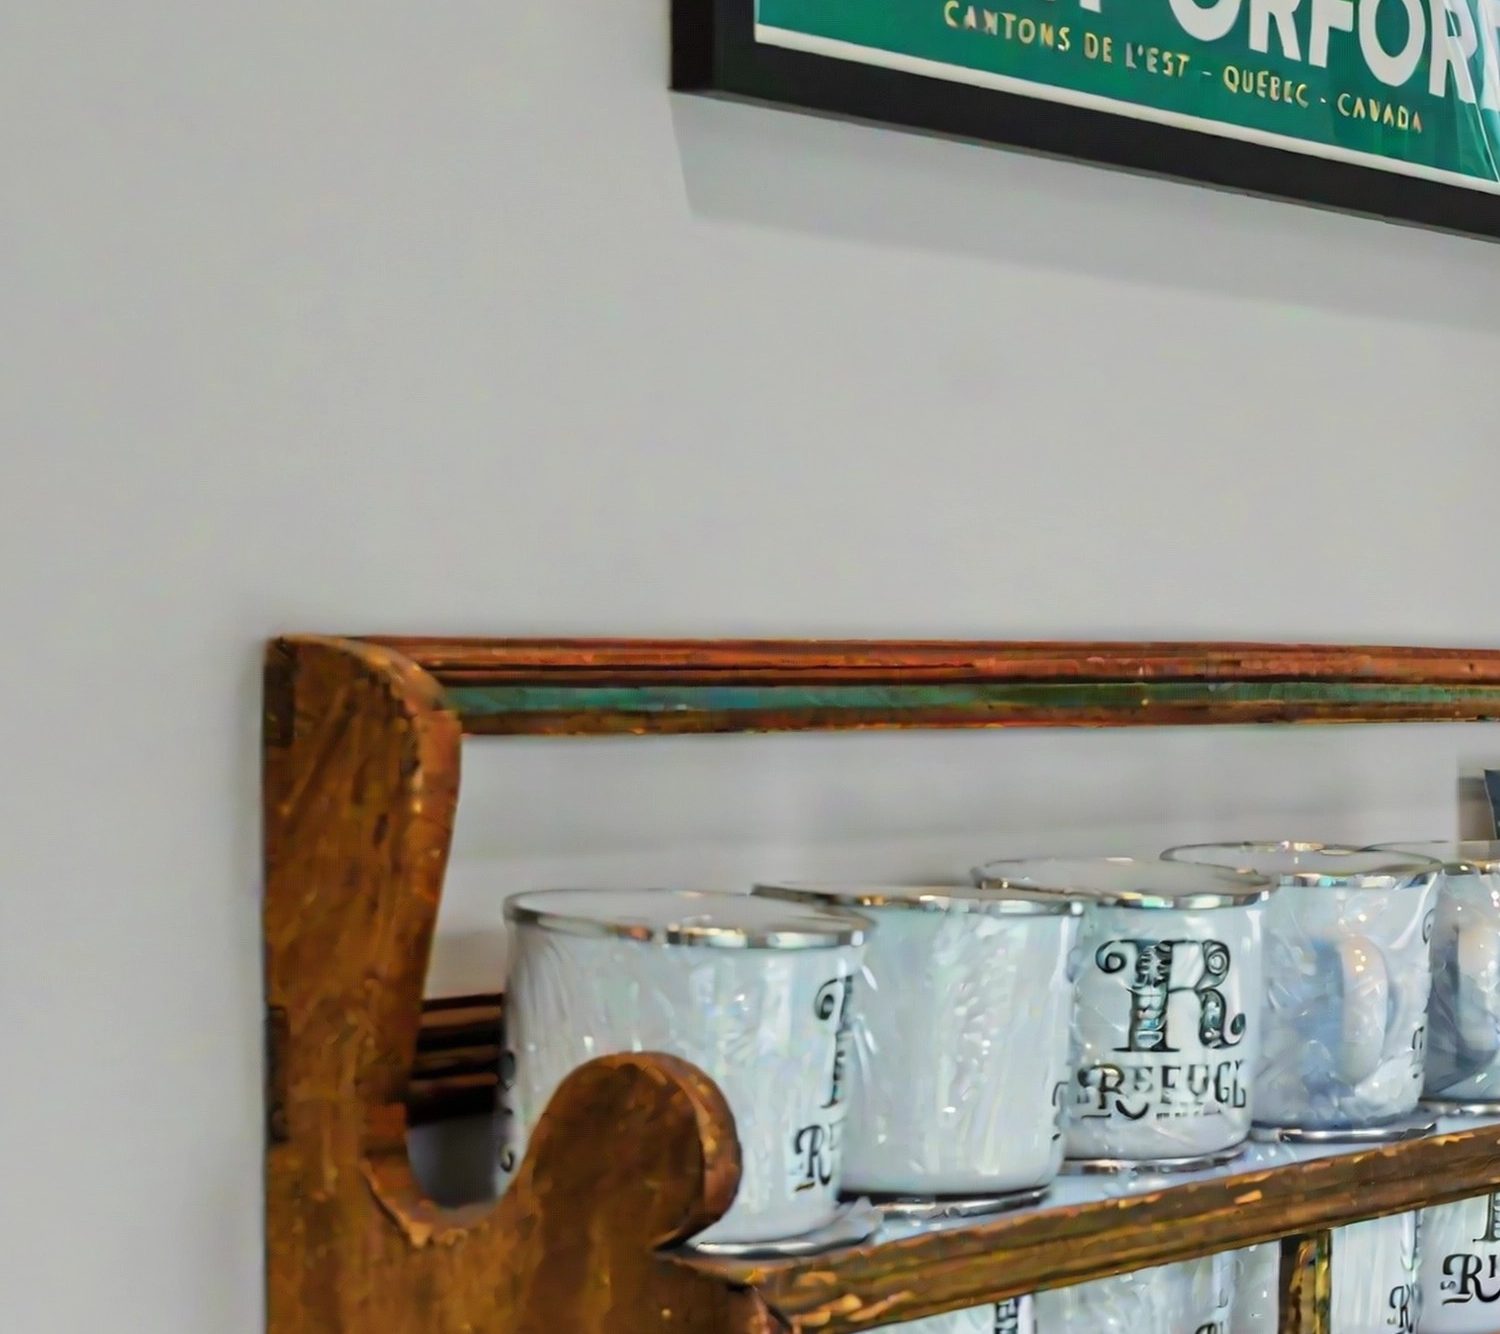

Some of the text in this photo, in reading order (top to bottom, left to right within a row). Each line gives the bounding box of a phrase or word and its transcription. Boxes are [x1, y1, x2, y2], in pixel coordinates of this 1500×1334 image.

[943, 0, 1072, 52] CANTONS
[1084, 32, 1114, 64] DE
[1125, 41, 1191, 78] L'EST
[1336, 93, 1423, 134] CANADA
